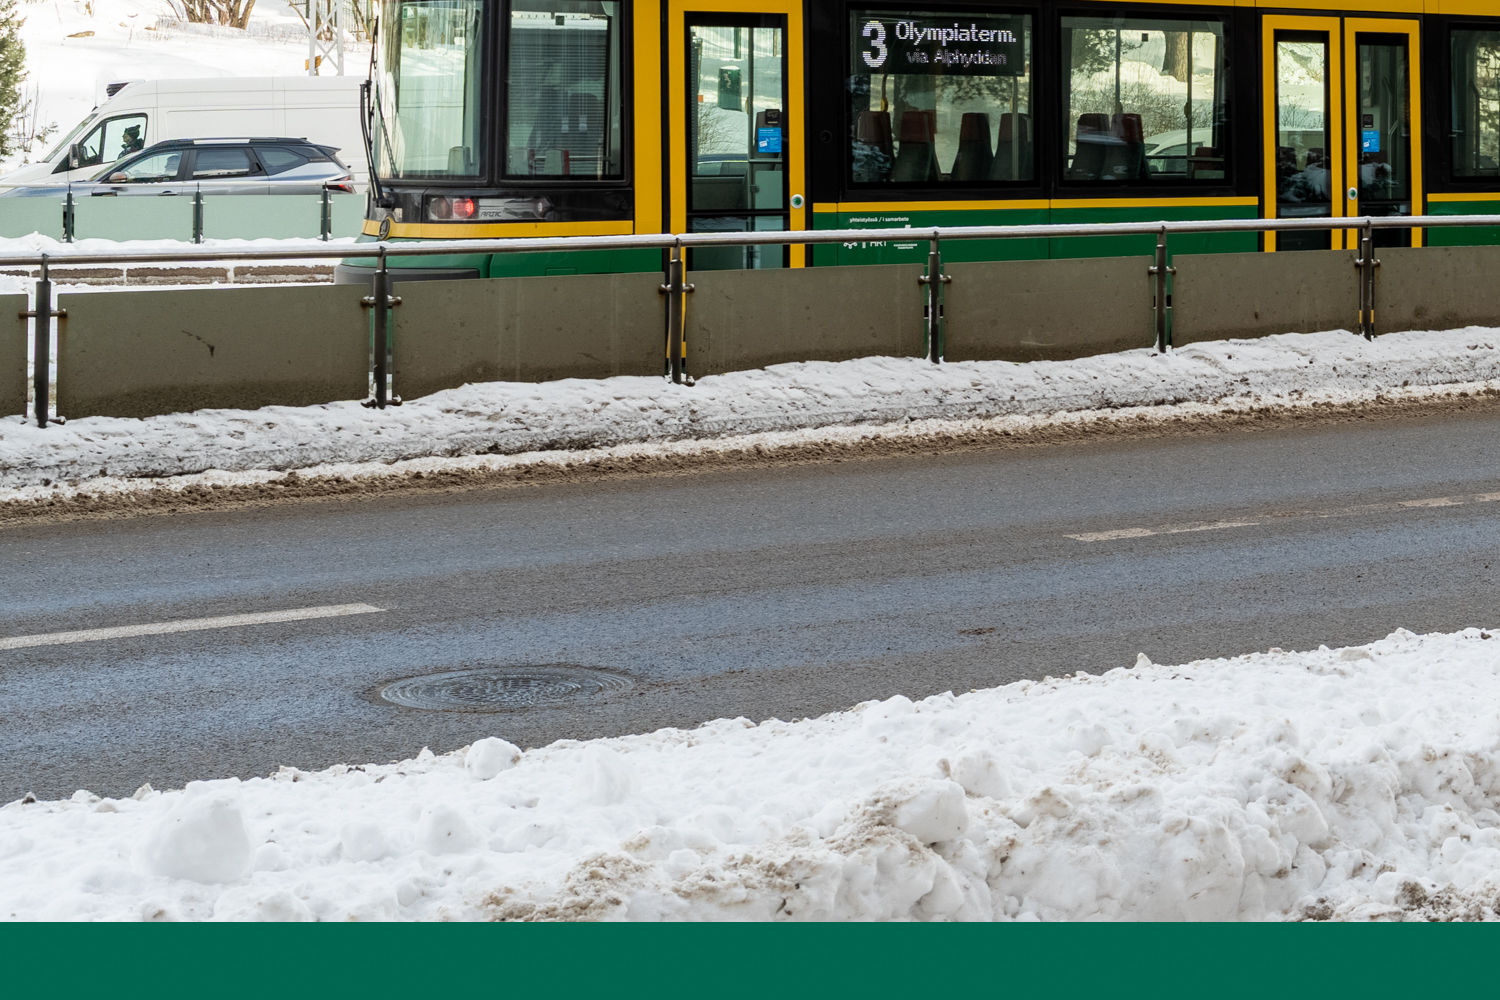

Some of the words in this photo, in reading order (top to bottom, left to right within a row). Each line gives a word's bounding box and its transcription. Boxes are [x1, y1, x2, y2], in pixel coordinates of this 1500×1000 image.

[862, 20, 888, 68] 3
[895, 21, 1017, 46] Olympiaterm.
[906, 48, 929, 64] via
[934, 49, 1007, 68] Alphyddan
